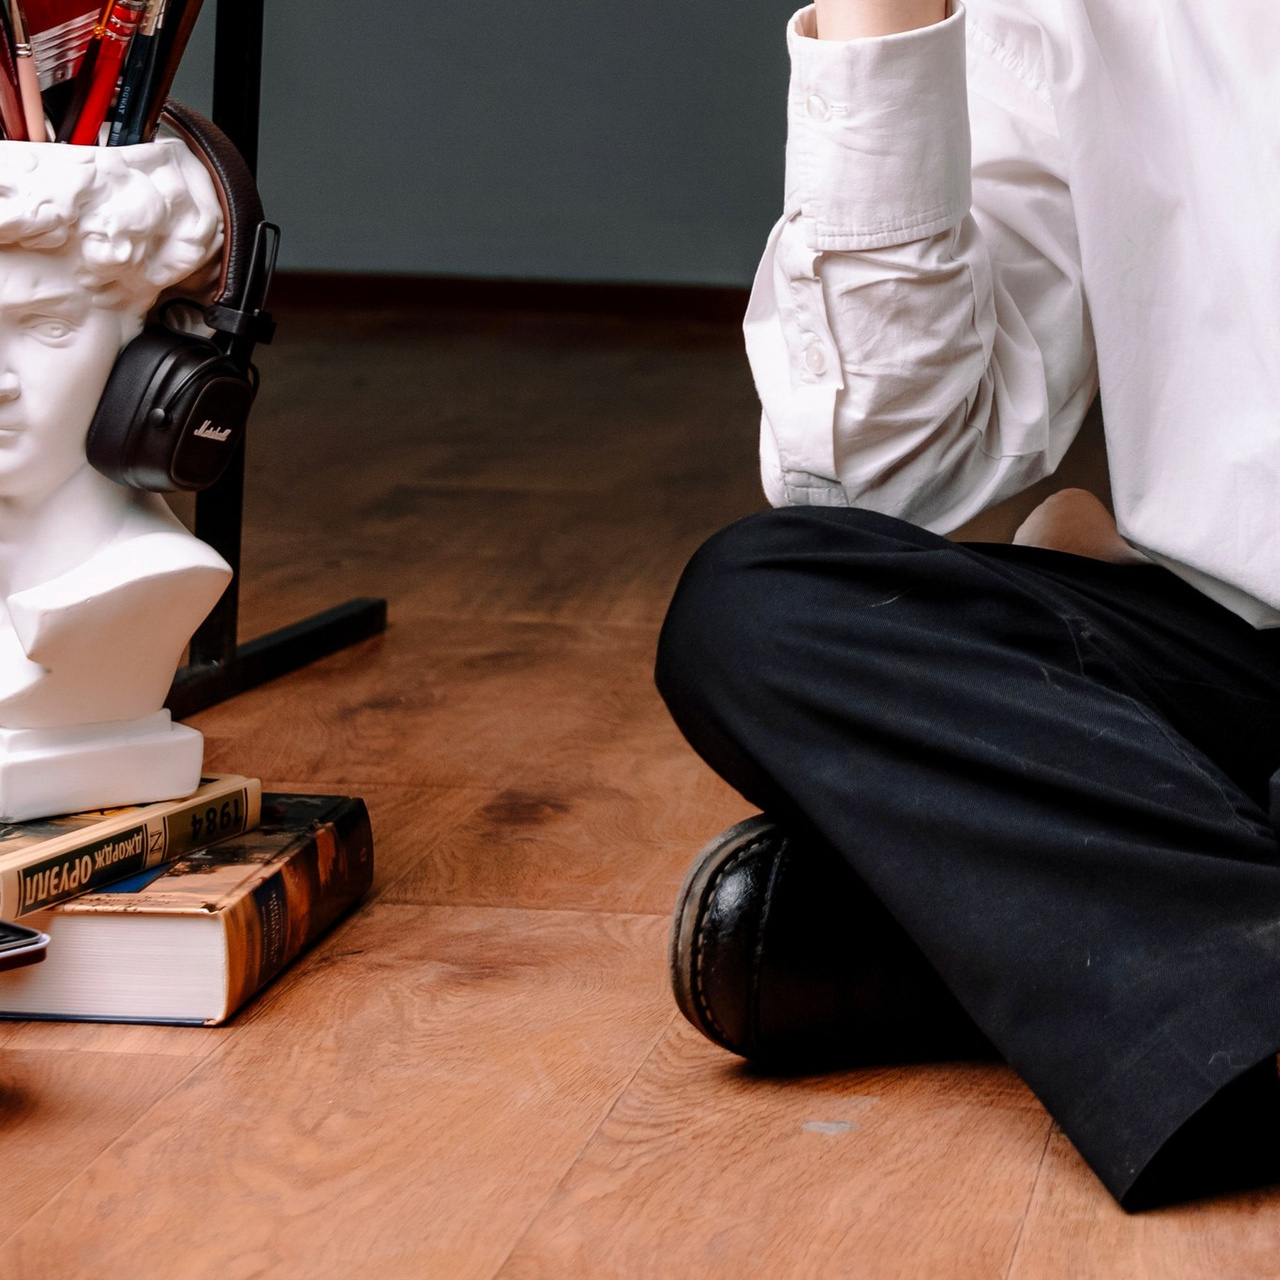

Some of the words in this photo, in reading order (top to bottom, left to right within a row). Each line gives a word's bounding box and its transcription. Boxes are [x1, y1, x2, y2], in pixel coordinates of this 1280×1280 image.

[191, 798, 242, 841] 1984
[94, 830, 144, 870] ДЖОРДЖ
[25, 854, 93, 907] ОРУЭЛЛ
